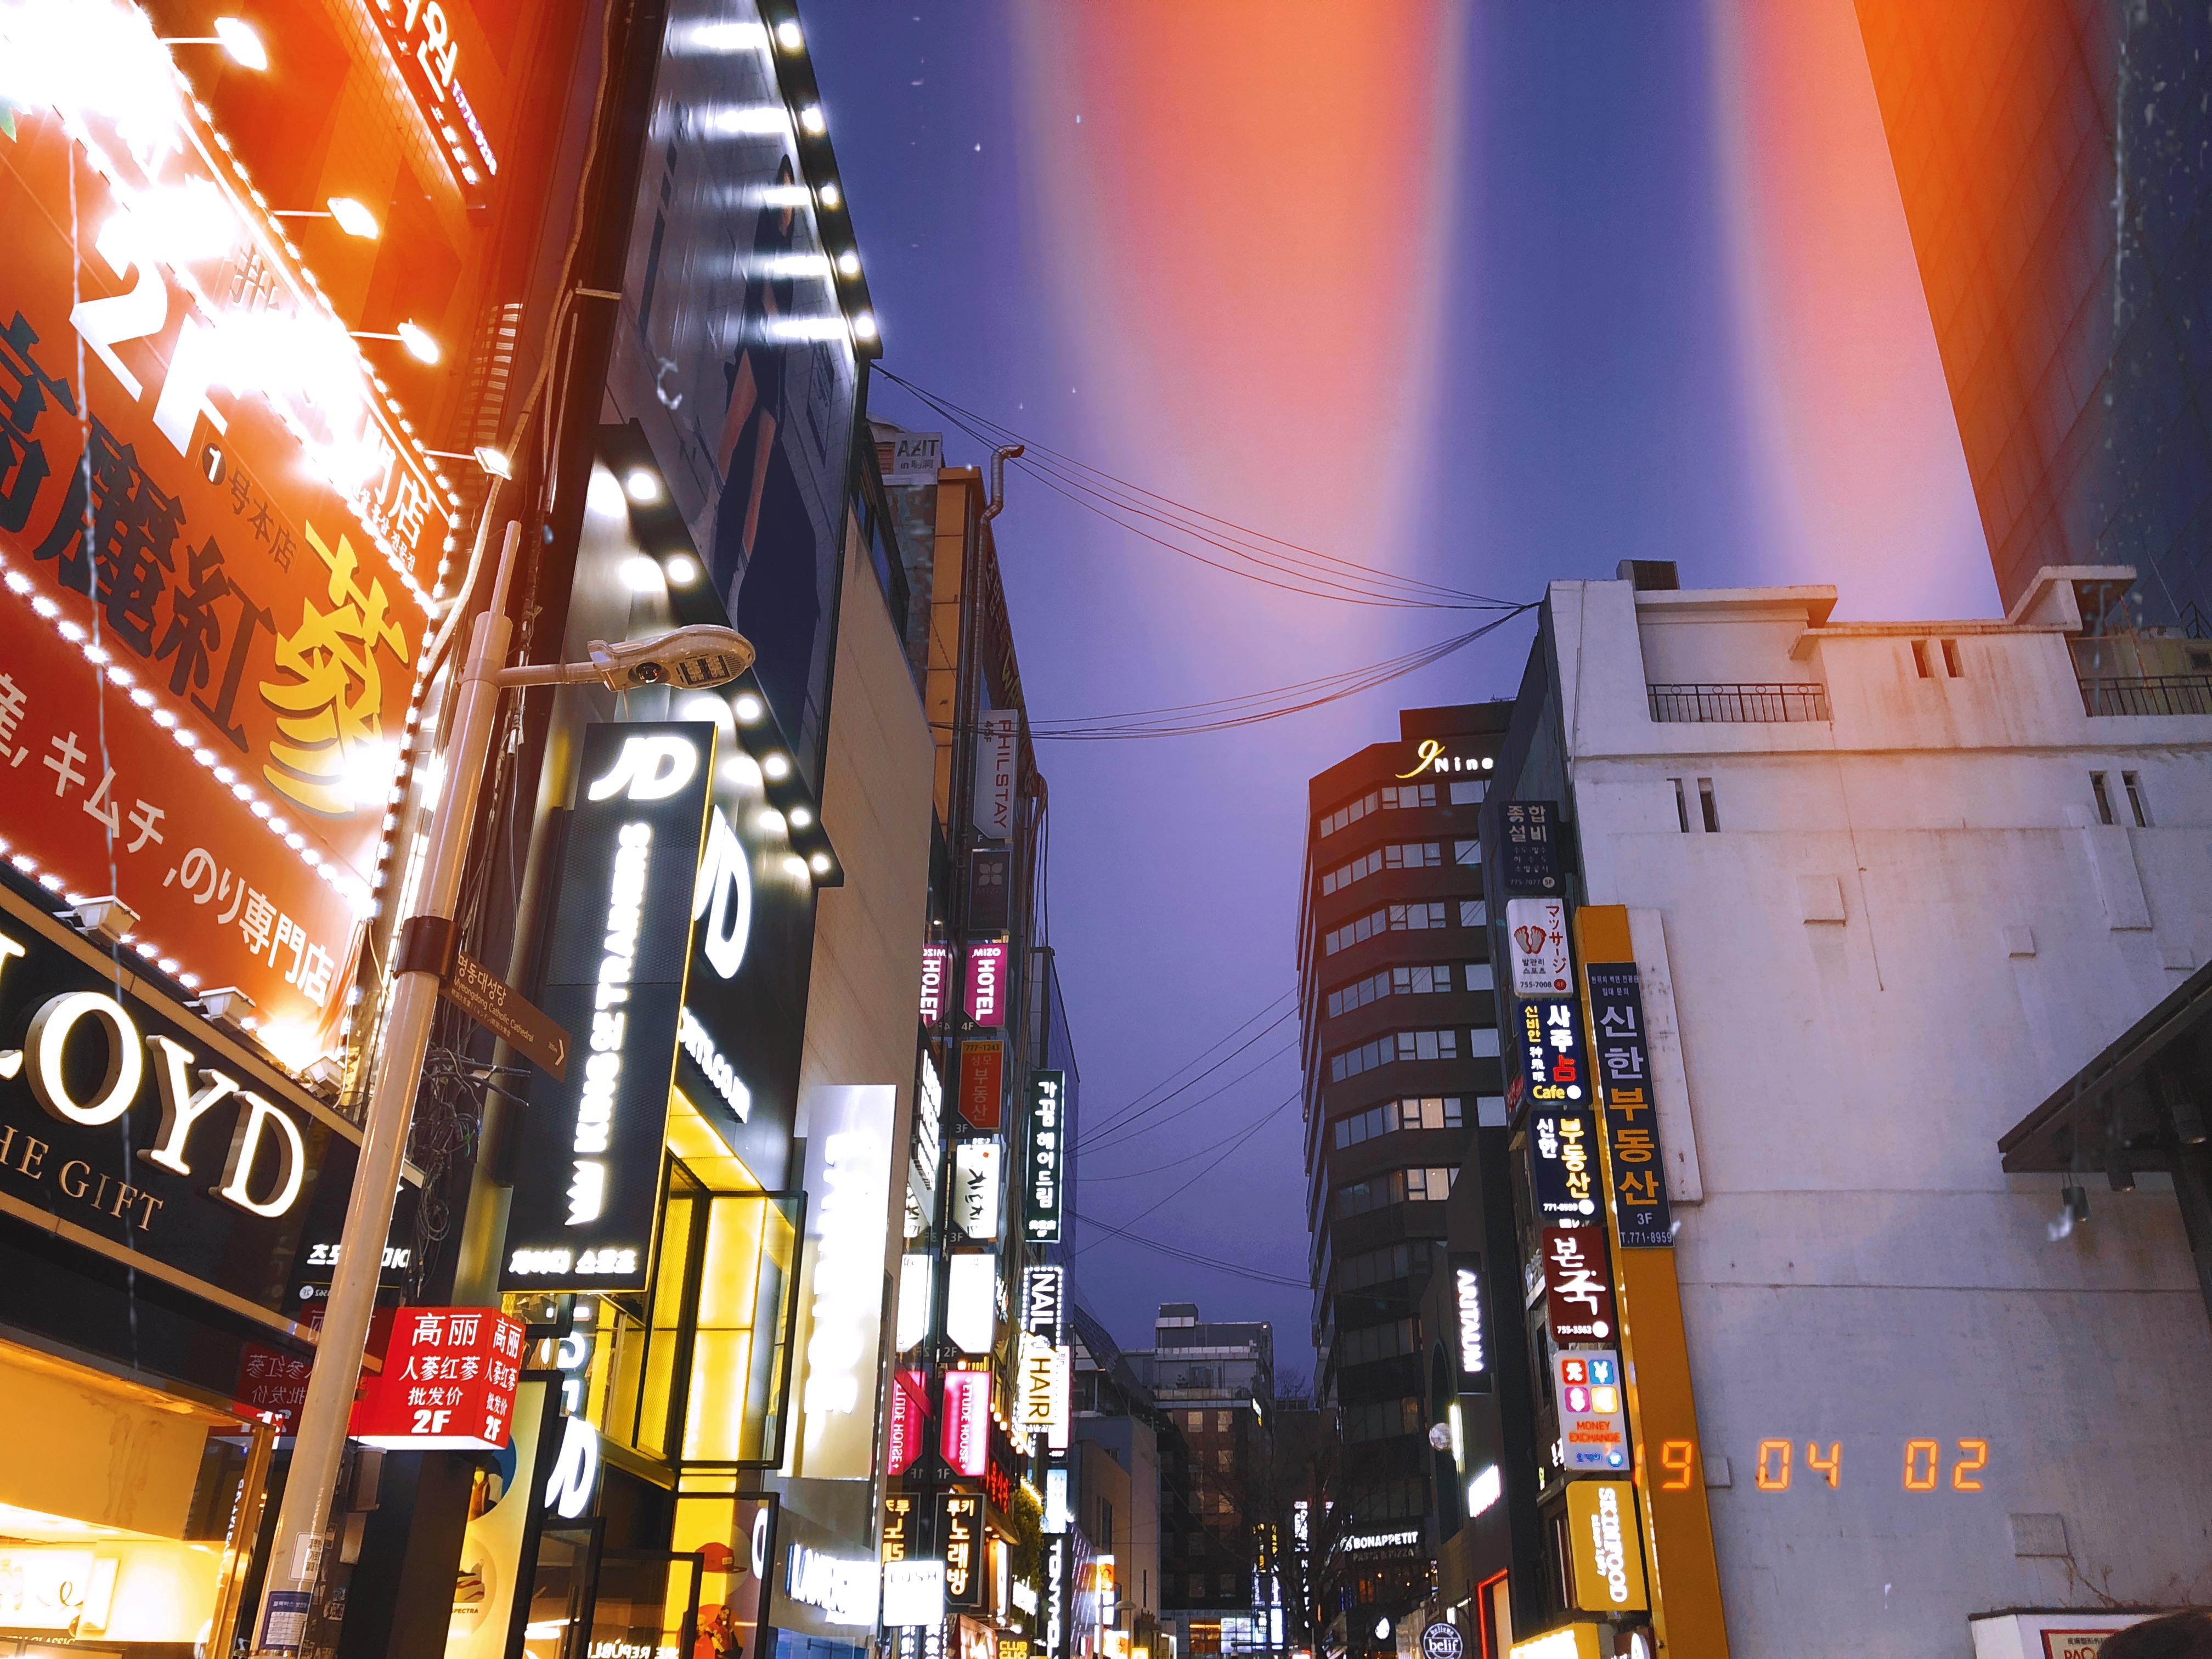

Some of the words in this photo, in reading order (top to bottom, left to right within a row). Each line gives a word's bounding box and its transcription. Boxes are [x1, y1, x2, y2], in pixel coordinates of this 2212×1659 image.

[897, 439, 939, 456] AZIT
[900, 461, 909, 469] in
[588, 736, 696, 800] JD
[994, 719, 1012, 829] PHILSTAY
[1434, 757, 1494, 773] Nine
[1507, 805, 1546, 822] 종합
[1509, 825, 1547, 843] 설비
[973, 948, 1002, 957] MIZO
[1522, 958, 1545, 966] 발관리
[458, 955, 507, 1007] 명동대성당
[975, 959, 996, 1021] HOTEL
[454, 975, 488, 1011] Myeongdong
[489, 1003, 510, 1025] Catholic
[510, 1019, 534, 1043] Cathedral
[961, 1022, 974, 1031] 4F
[1525, 1005, 1542, 1042] 신비안
[1599, 1006, 1644, 1080] 신한
[972, 1055, 992, 1066] 성모
[0, 936, 304, 1218] OYD
[972, 1068, 989, 1121] 부동산
[1532, 1085, 1566, 1100] Cafe
[955, 1124, 968, 1133] 3F
[1537, 1118, 1558, 1159] 신한
[1559, 1118, 1591, 1199] 부동산
[1609, 1087, 1659, 1205] 부동산
[58, 1160, 164, 1231] GIFT
[1637, 1212, 1653, 1225] 3F
[950, 1232, 964, 1243] 3F
[1620, 1231, 1673, 1244] T.771-8959
[1029, 1273, 1056, 1333] NAIL
[412, 1312, 482, 1347] 高丽
[1457, 1269, 1483, 1373] ARITAUM
[493, 1317, 522, 1360] 高丽
[943, 1346, 958, 1358] 2F
[408, 1386, 464, 1407] 批发价
[1028, 1357, 1051, 1418] HAIR
[486, 1391, 508, 1418] 批发价
[961, 1384, 973, 1424] ETUDE
[411, 1409, 452, 1434] 2F
[483, 1415, 502, 1441] 2F
[1576, 1421, 1610, 1430] MONEY
[959, 1425, 970, 1464] HOUSE
[1568, 1432, 1621, 1443] EXCHANGE
[937, 1468, 950, 1480] 1F
[1353, 1531, 1418, 1549] BONAPPETIT
[1598, 1487, 1628, 1603] SKINFOOD
[946, 1518, 970, 1595] 노래방
[1047, 1539, 1062, 1659] TONYMOL
[999, 1641, 1028, 1651] CLUB
[999, 1651, 1028, 1659] CLIO
[1428, 1638, 1459, 1651] belif
